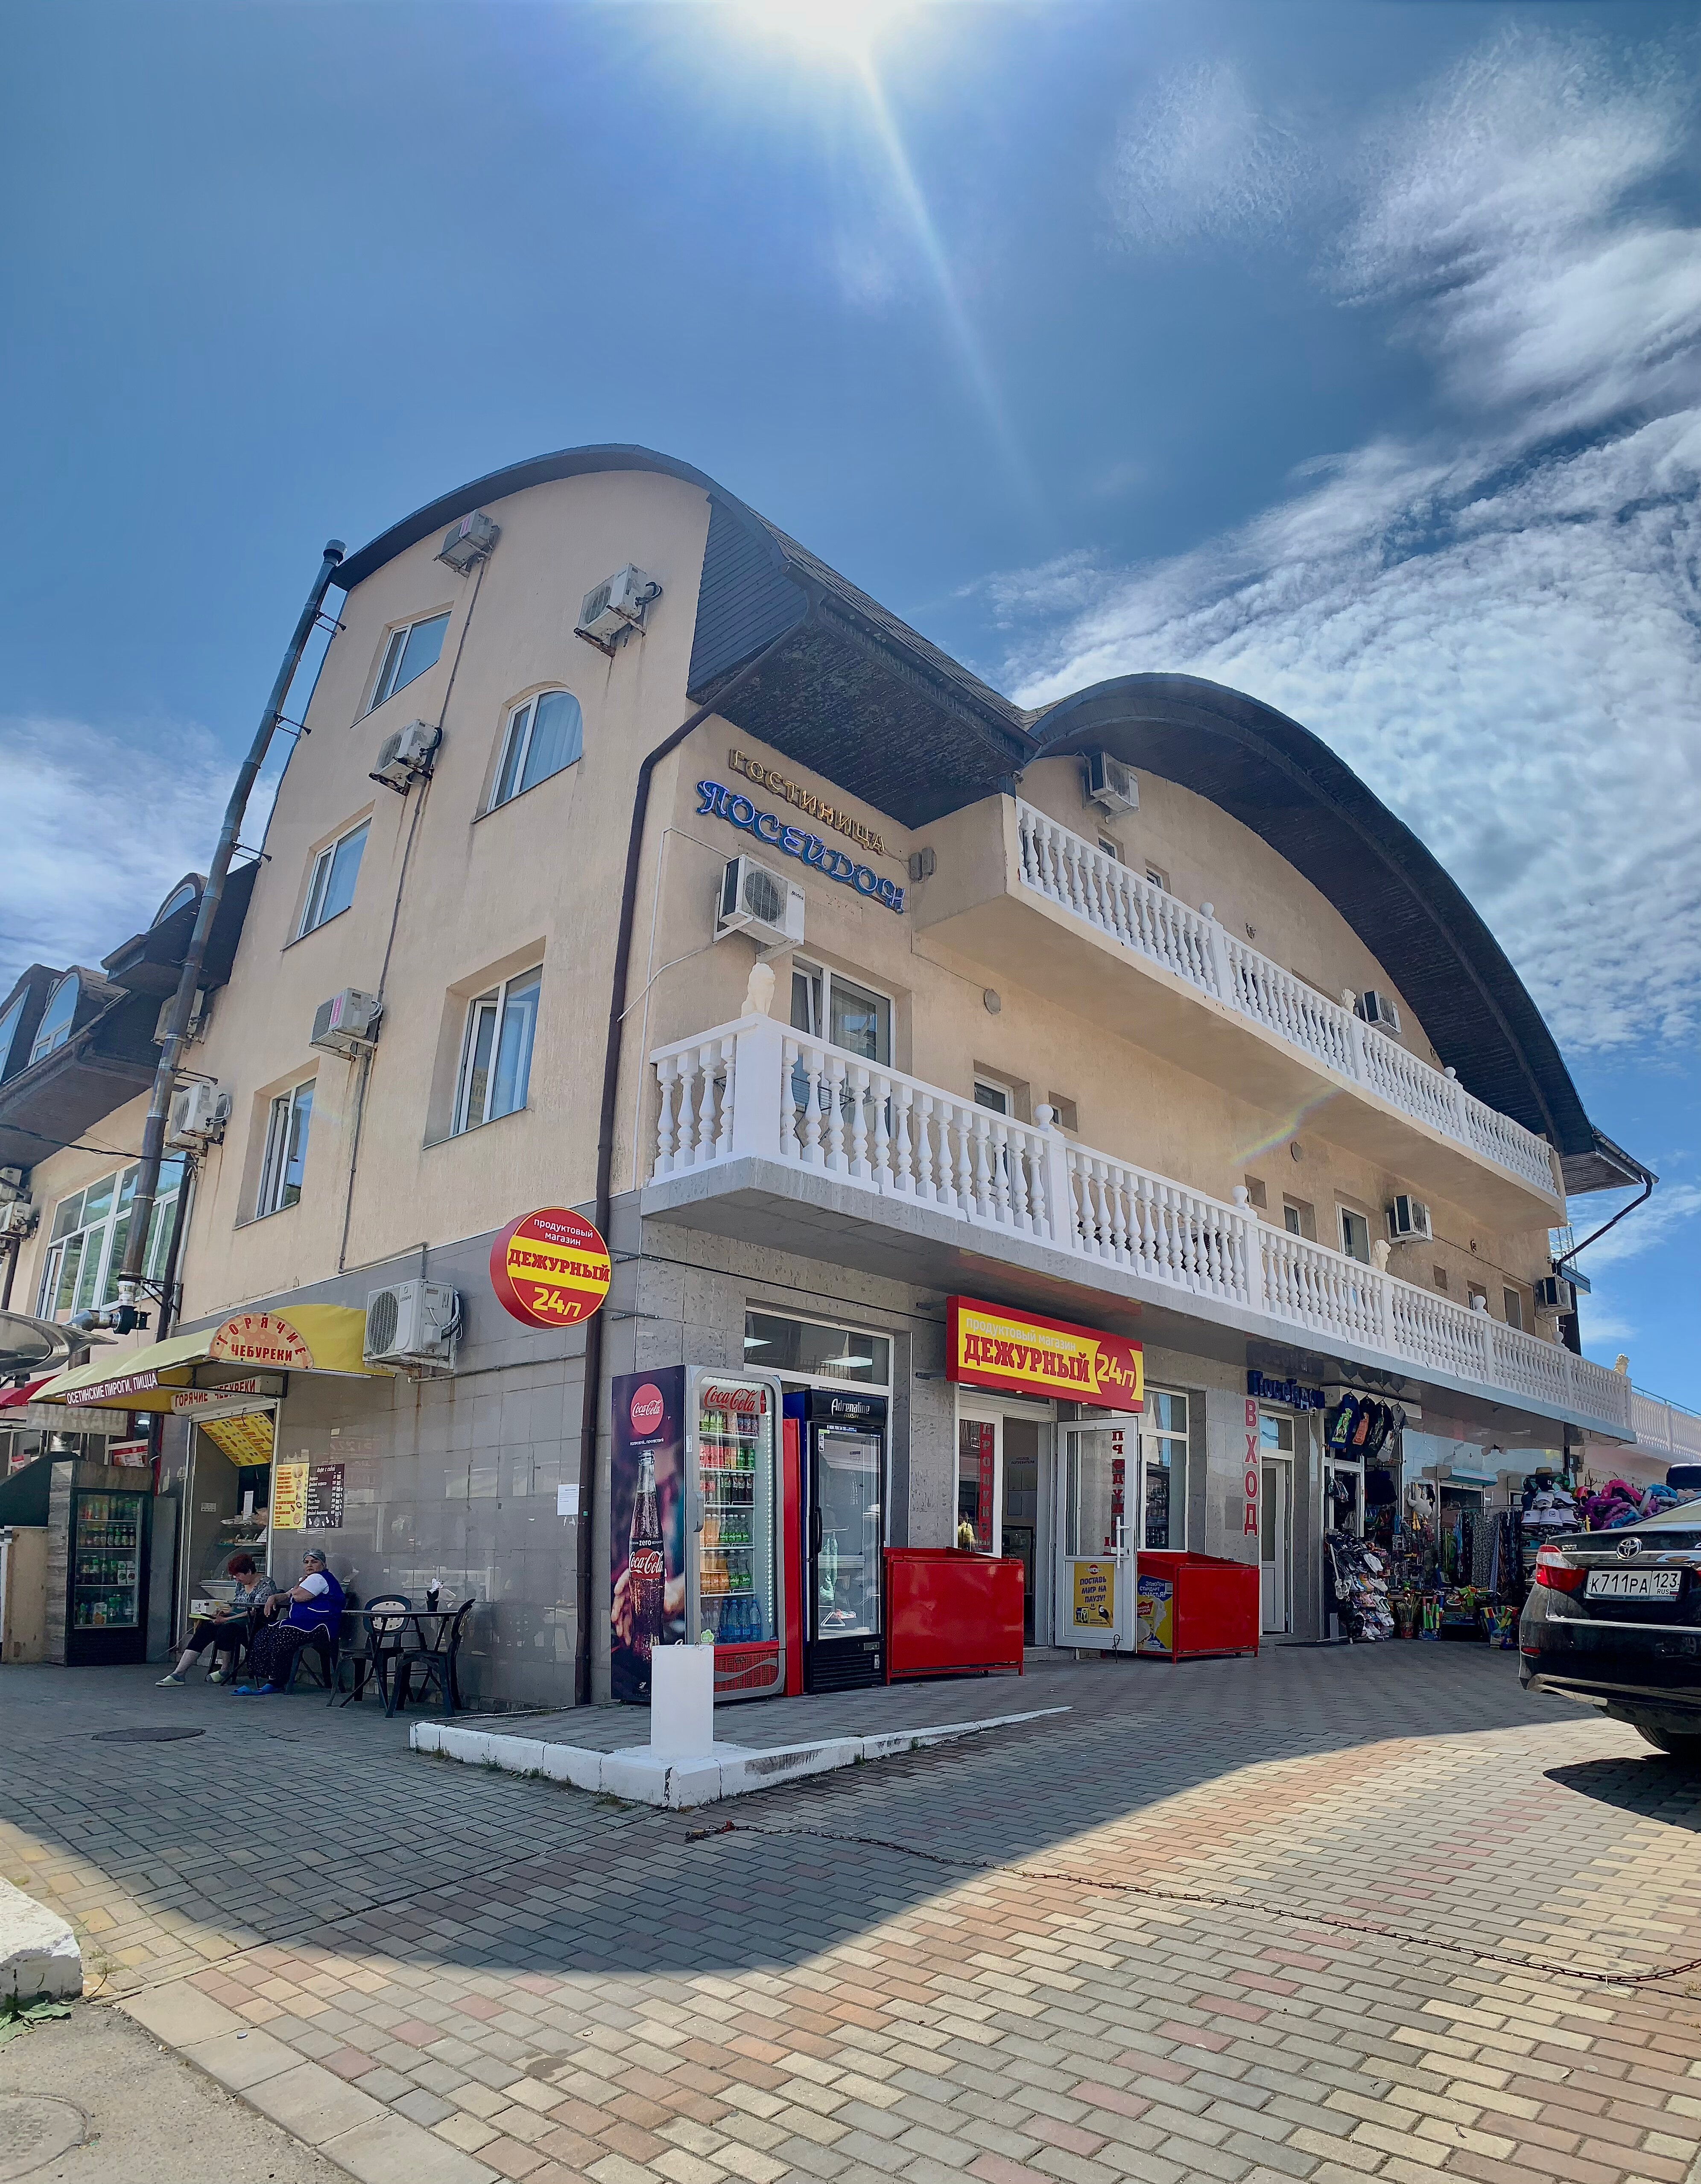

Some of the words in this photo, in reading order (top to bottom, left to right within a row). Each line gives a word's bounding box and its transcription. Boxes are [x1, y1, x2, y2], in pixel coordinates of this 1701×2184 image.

[728, 748, 885, 854] ГОСТИНИЦА
[696, 780, 905, 914] ПОСЕЙДОН
[790, 891, 804, 900] Midea
[534, 1218, 593, 1238] продуктовый
[545, 1232, 581, 1246] магазин
[508, 1248, 610, 1282] ДЕЖУРНЫЙ
[532, 1286, 582, 1318] 24/7
[217, 1317, 306, 1355] ГОРЯЧИЕ
[965, 1317, 1037, 1343] продуктовый
[1038, 1335, 1076, 1352] магазин
[231, 1344, 293, 1362] ЧЕБУРЕКИ
[964, 1333, 1090, 1383] ДЕЖУРНЫЙ
[1096, 1353, 1136, 1388] 24/7
[66, 1386, 105, 1405] ОСЕТИНСКИЕ
[105, 1379, 133, 1397] ПИРОГИ,
[133, 1372, 158, 1390] ПИЦЦА
[175, 1393, 208, 1407] ГОРЯЧИЕ
[704, 1385, 759, 1412] Coca-Cola
[632, 1399, 663, 1417] Coca-Cola
[831, 1398, 870, 1416] Adrenaline
[1244, 1399, 1258, 1537] ВХОД
[629, 1550, 663, 1574] Coca-Cola
[1079, 1576, 1107, 1585] ПОСТАВЬ
[1081, 1586, 1096, 1594] МИР
[1653, 1573, 1678, 1588] 123
[1084, 1594, 1106, 1603] ПАУЗУ!
